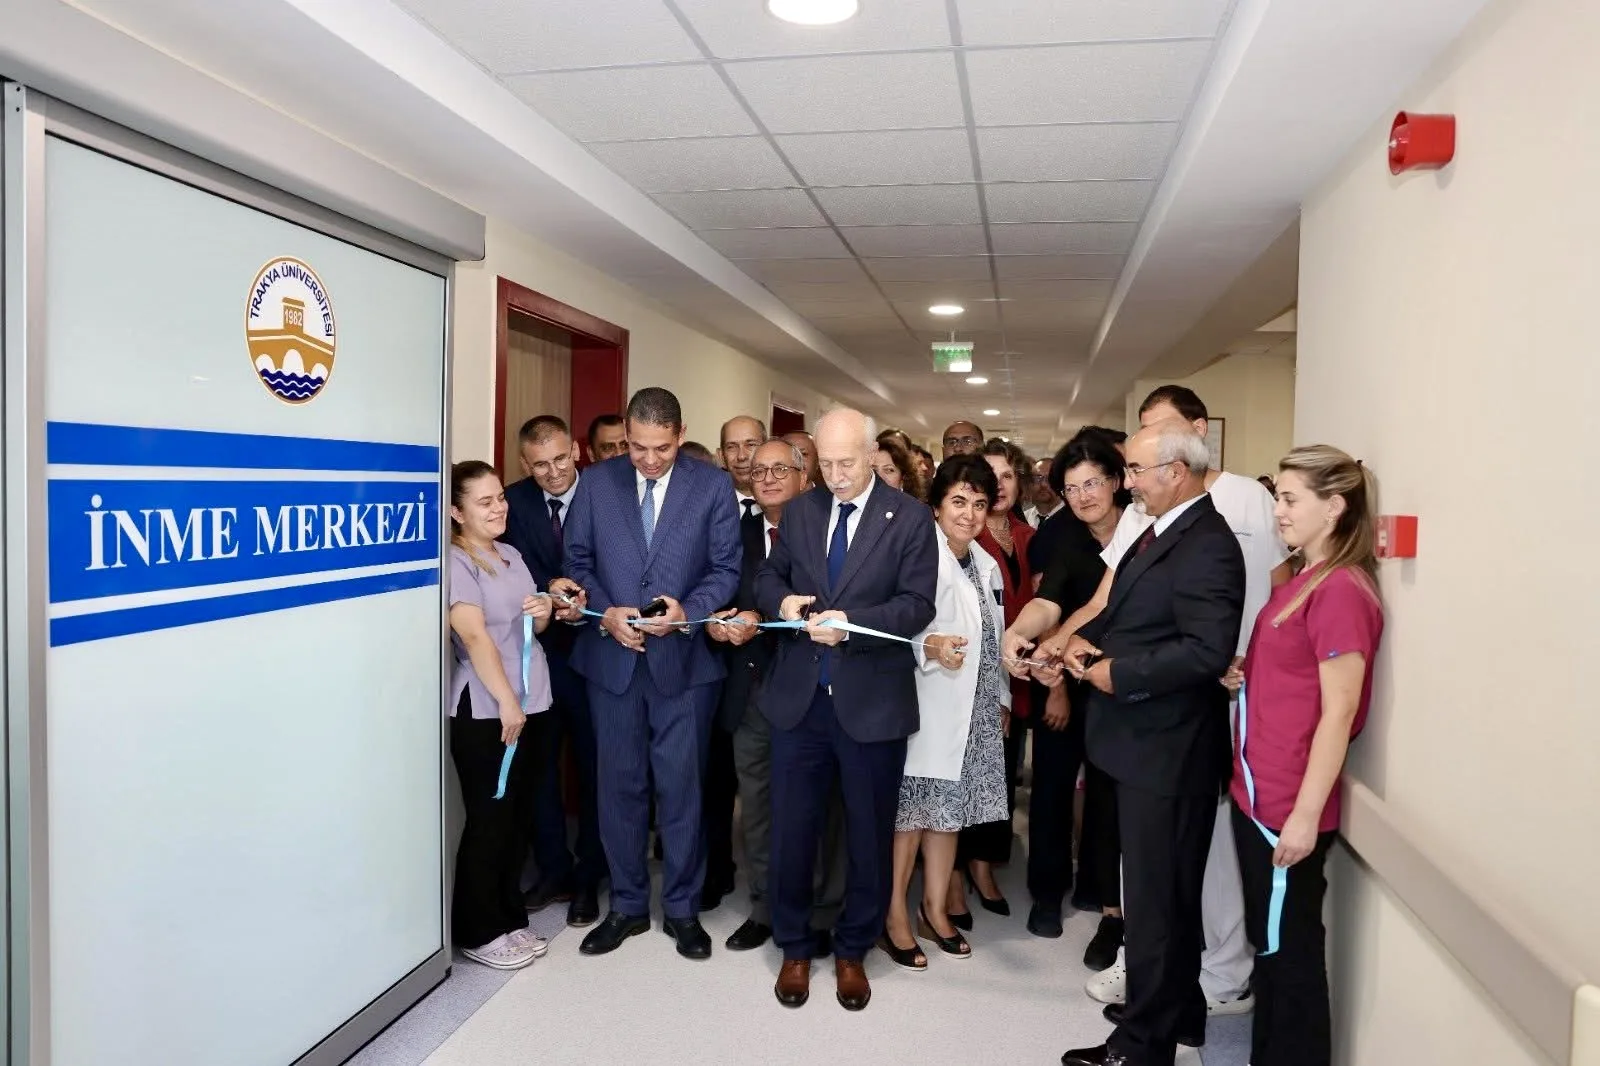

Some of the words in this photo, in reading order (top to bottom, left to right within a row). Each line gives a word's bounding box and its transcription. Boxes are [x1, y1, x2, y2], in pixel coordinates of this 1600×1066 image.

[250, 268, 281, 319] TRAKYA
[284, 309, 303, 326] 1982
[84, 494, 240, 571] İNME
[252, 491, 427, 556] MERKEZİ
